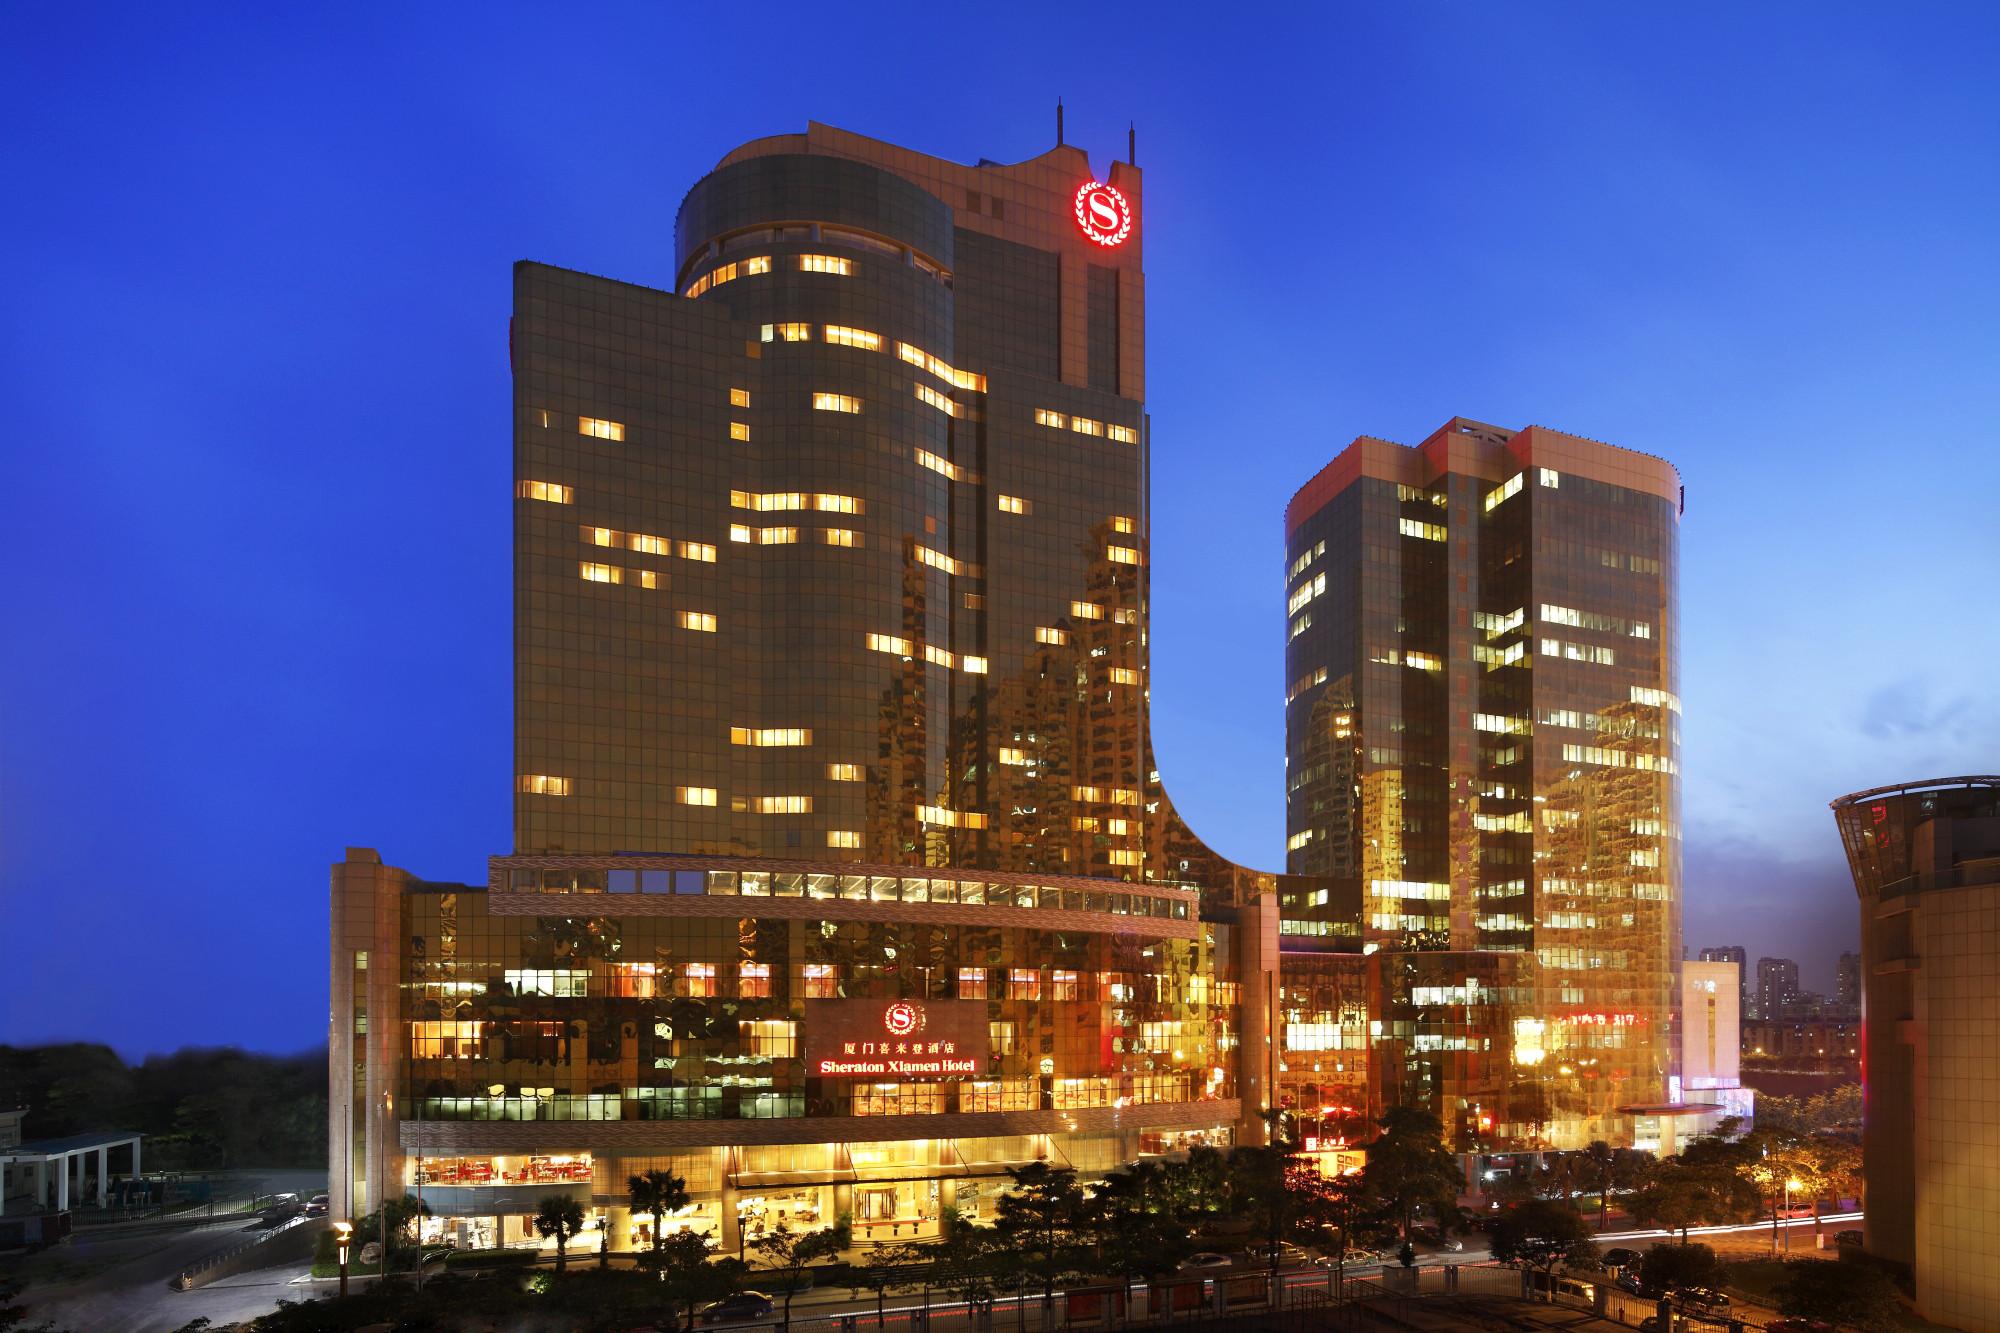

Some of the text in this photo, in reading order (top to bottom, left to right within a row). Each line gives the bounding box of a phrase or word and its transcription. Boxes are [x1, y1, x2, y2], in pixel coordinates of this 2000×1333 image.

[1089, 192, 1118, 230] S
[892, 1008, 910, 1028] S
[844, 1042, 955, 1055] 厦门喜来登酒店
[820, 1059, 975, 1073] Sheraton Xiamen Hotel
